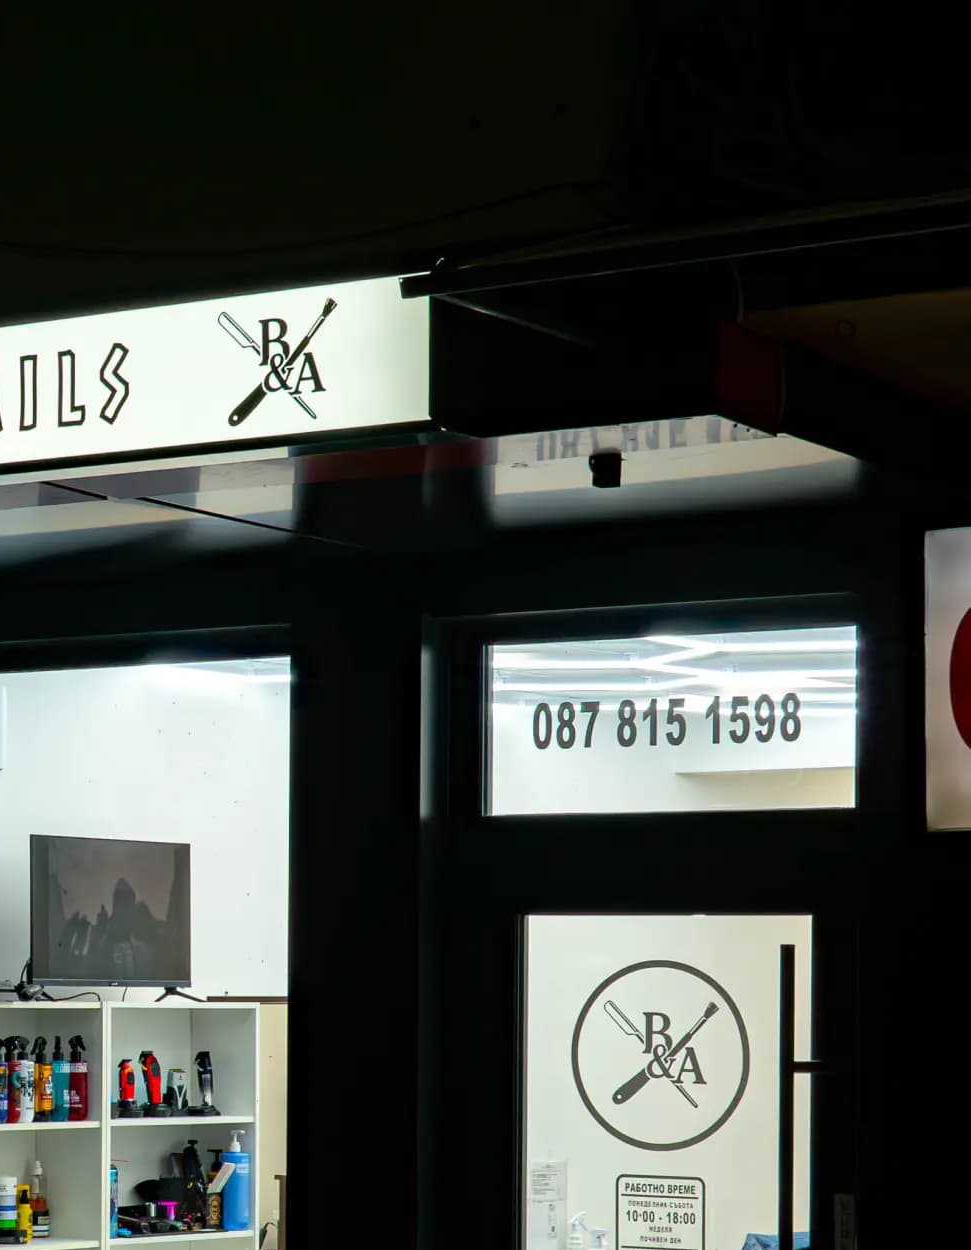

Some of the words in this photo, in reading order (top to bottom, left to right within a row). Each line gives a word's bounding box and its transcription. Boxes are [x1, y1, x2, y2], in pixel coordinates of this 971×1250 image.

[532, 700, 601, 750] 087
[616, 698, 687, 749] 815
[705, 692, 801, 744] 1598
[642, 1011, 707, 1085] B&A
[624, 1182, 665, 1194] РАБОТНО
[667, 1184, 697, 1195] ВРЕМЕ
[666, 1211, 696, 1225] 18:00
